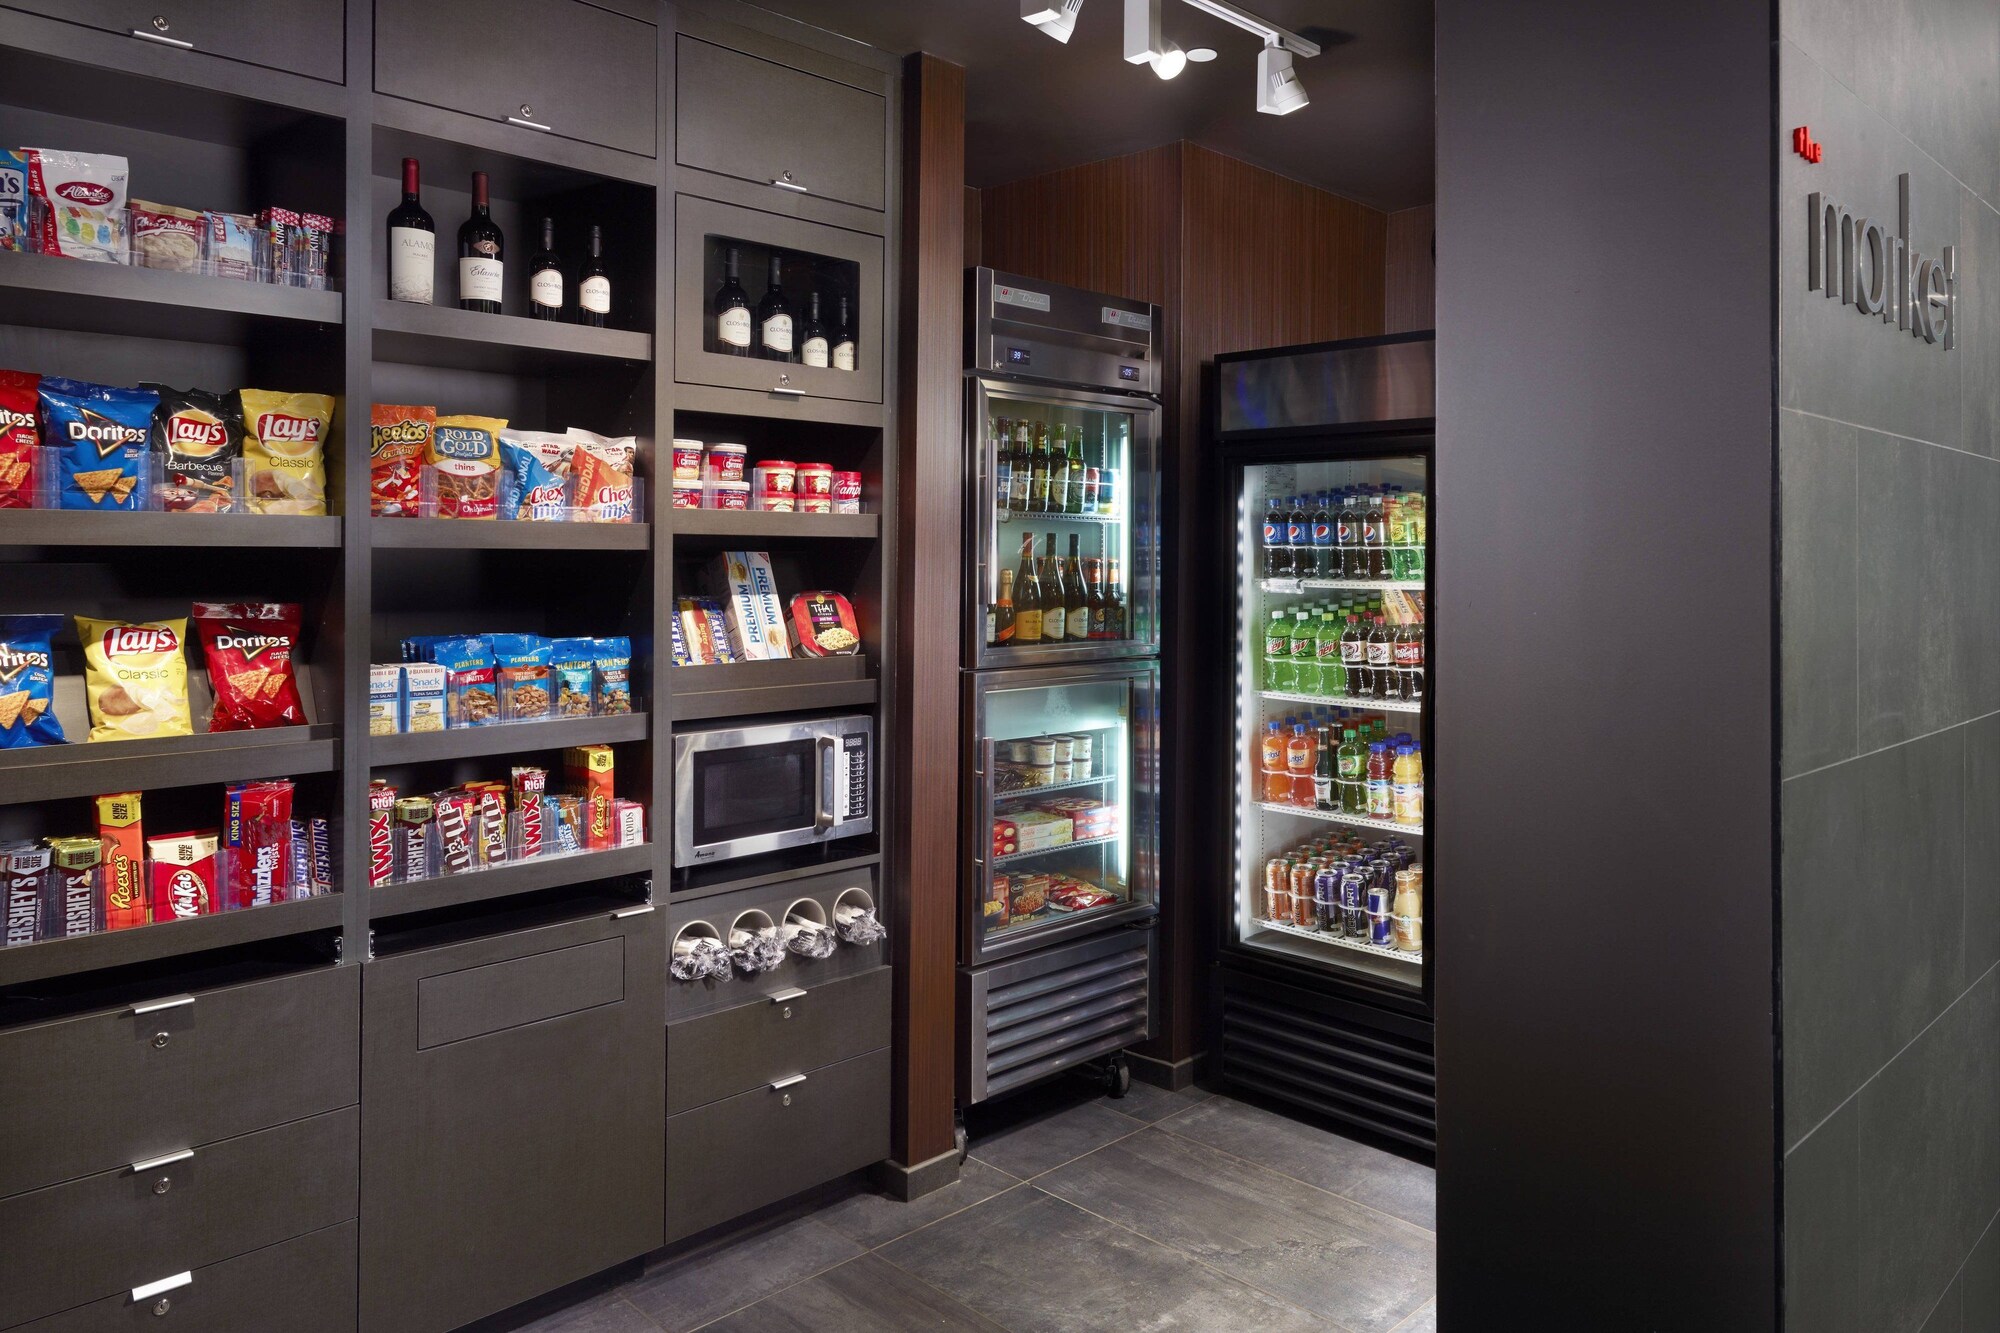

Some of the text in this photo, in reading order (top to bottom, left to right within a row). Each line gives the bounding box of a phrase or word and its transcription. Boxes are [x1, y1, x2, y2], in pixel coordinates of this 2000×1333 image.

[1794, 127, 1822, 163] the
[276, 222, 285, 245] KIND
[310, 228, 319, 251] KIND
[470, 265, 500, 278] Estancia
[1808, 173, 1955, 351] market
[1014, 351, 1021, 360] 39
[69, 422, 147, 442] Doritos
[171, 418, 222, 444] Lay's
[263, 414, 318, 442] Lay's
[371, 421, 427, 452] heetos
[444, 428, 484, 441] ROLD
[381, 446, 414, 459] Crunchy
[441, 439, 487, 455] GOLD
[167, 461, 223, 472] Barbecue
[269, 456, 314, 468] Classic
[531, 487, 564, 505] Chex
[599, 487, 632, 503] Chex
[533, 500, 564, 519] mix
[602, 501, 632, 519] mix
[756, 567, 777, 625] PREMIUM
[737, 584, 760, 643] PREMIUM
[811, 604, 834, 613] THAI
[109, 628, 171, 656] Lay's
[217, 635, 290, 650] Doritos
[699, 623, 708, 645] Butter
[0, 652, 48, 667] ritos
[454, 659, 484, 669] PLANTERS
[556, 661, 591, 671] PLANTERS
[596, 657, 630, 668] PLANTERS
[118, 669, 169, 680] Classic
[412, 677, 440, 687] Snack
[112, 803, 120, 820] KING
[120, 803, 128, 820] SIZE
[231, 801, 240, 841] KING SIZE
[590, 795, 604, 838] Reese's
[522, 794, 542, 857] TWIX
[563, 823, 578, 853] TREATS
[178, 844, 186, 860] KING
[270, 842, 280, 870] twists
[313, 819, 331, 883] SNICKERS
[369, 812, 394, 888] TWIX
[110, 854, 131, 909] Reese's
[252, 846, 272, 907] Twizzlers
